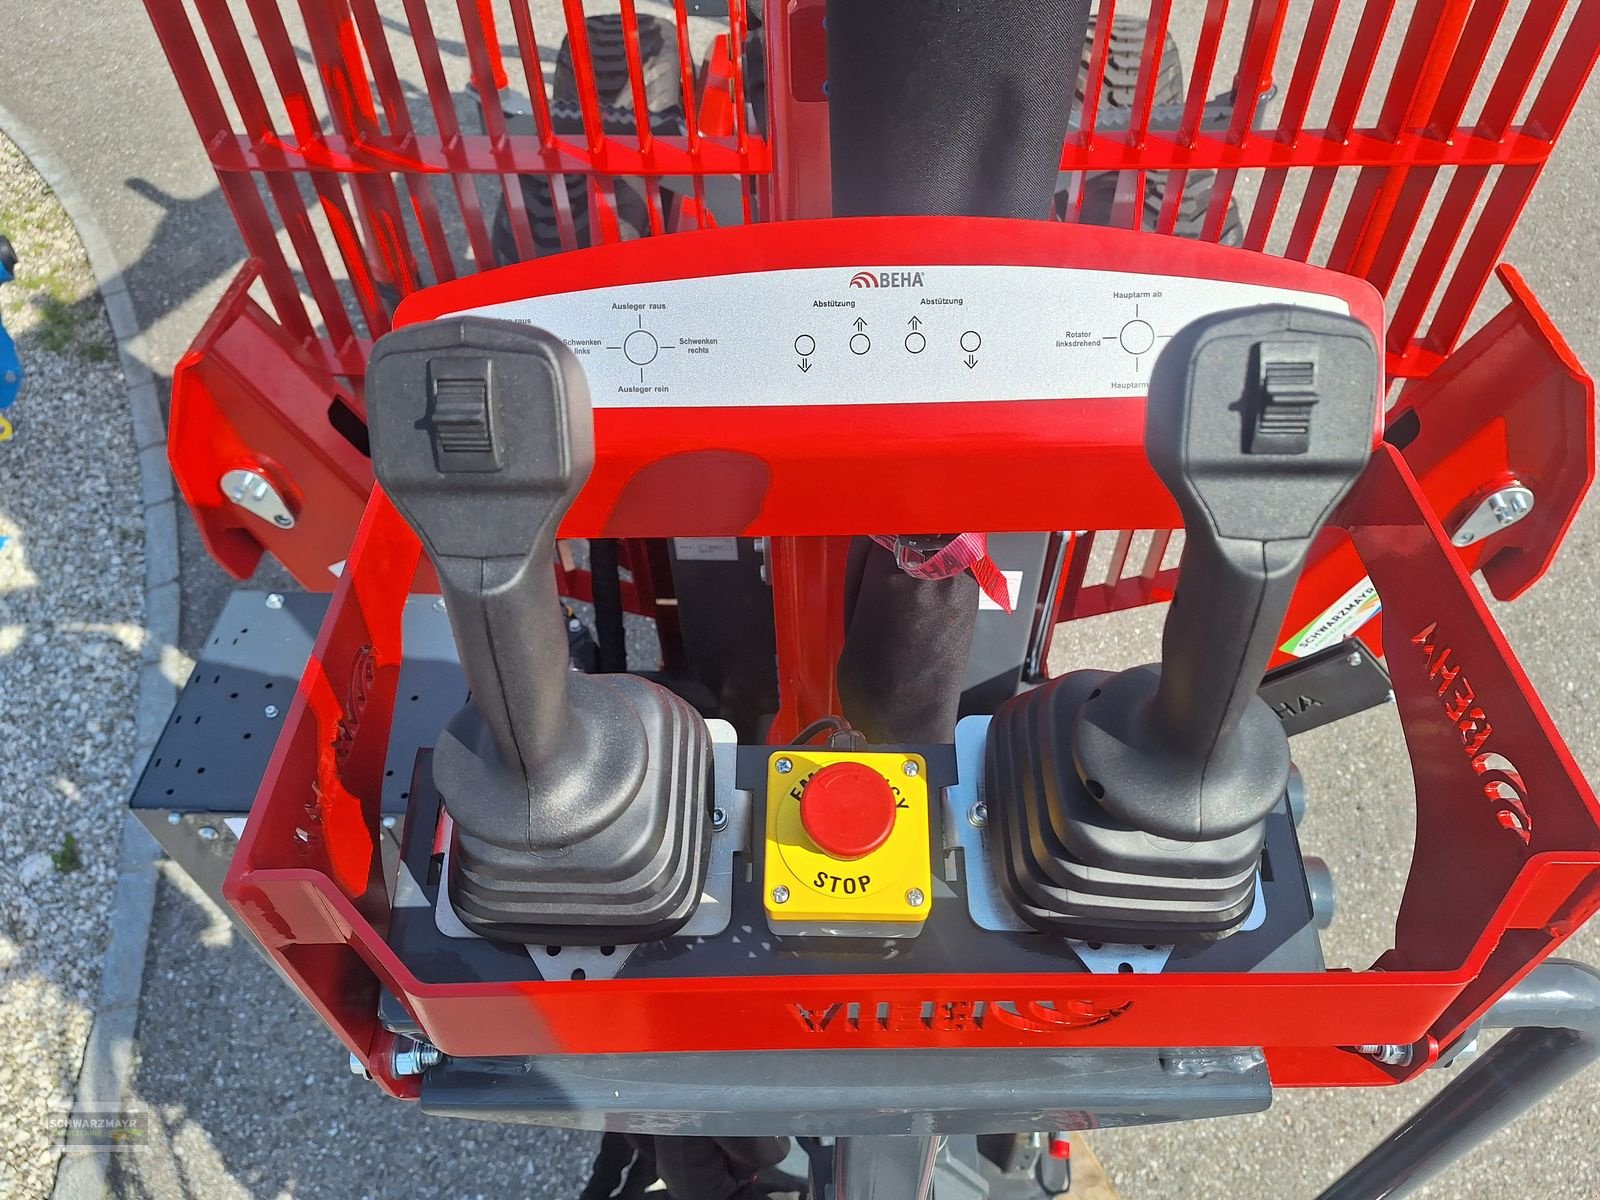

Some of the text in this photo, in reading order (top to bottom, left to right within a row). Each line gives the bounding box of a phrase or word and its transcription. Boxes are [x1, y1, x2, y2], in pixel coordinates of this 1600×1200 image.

[879, 272, 924, 288] BEHA
[1113, 291, 1150, 300] Hauptarm
[611, 302, 646, 311] Ausleger
[812, 300, 856, 309] Abstützung
[920, 297, 964, 307] Abstützung
[679, 337, 718, 345] Schwenken
[1055, 339, 1101, 347] linksdrehend
[574, 347, 591, 355] links
[687, 346, 710, 354] rechts
[617, 385, 670, 394] Ausleger rein
[1111, 382, 1149, 390] Hauptarm
[1271, 695, 1324, 721] HA
[813, 871, 872, 895] STOP
